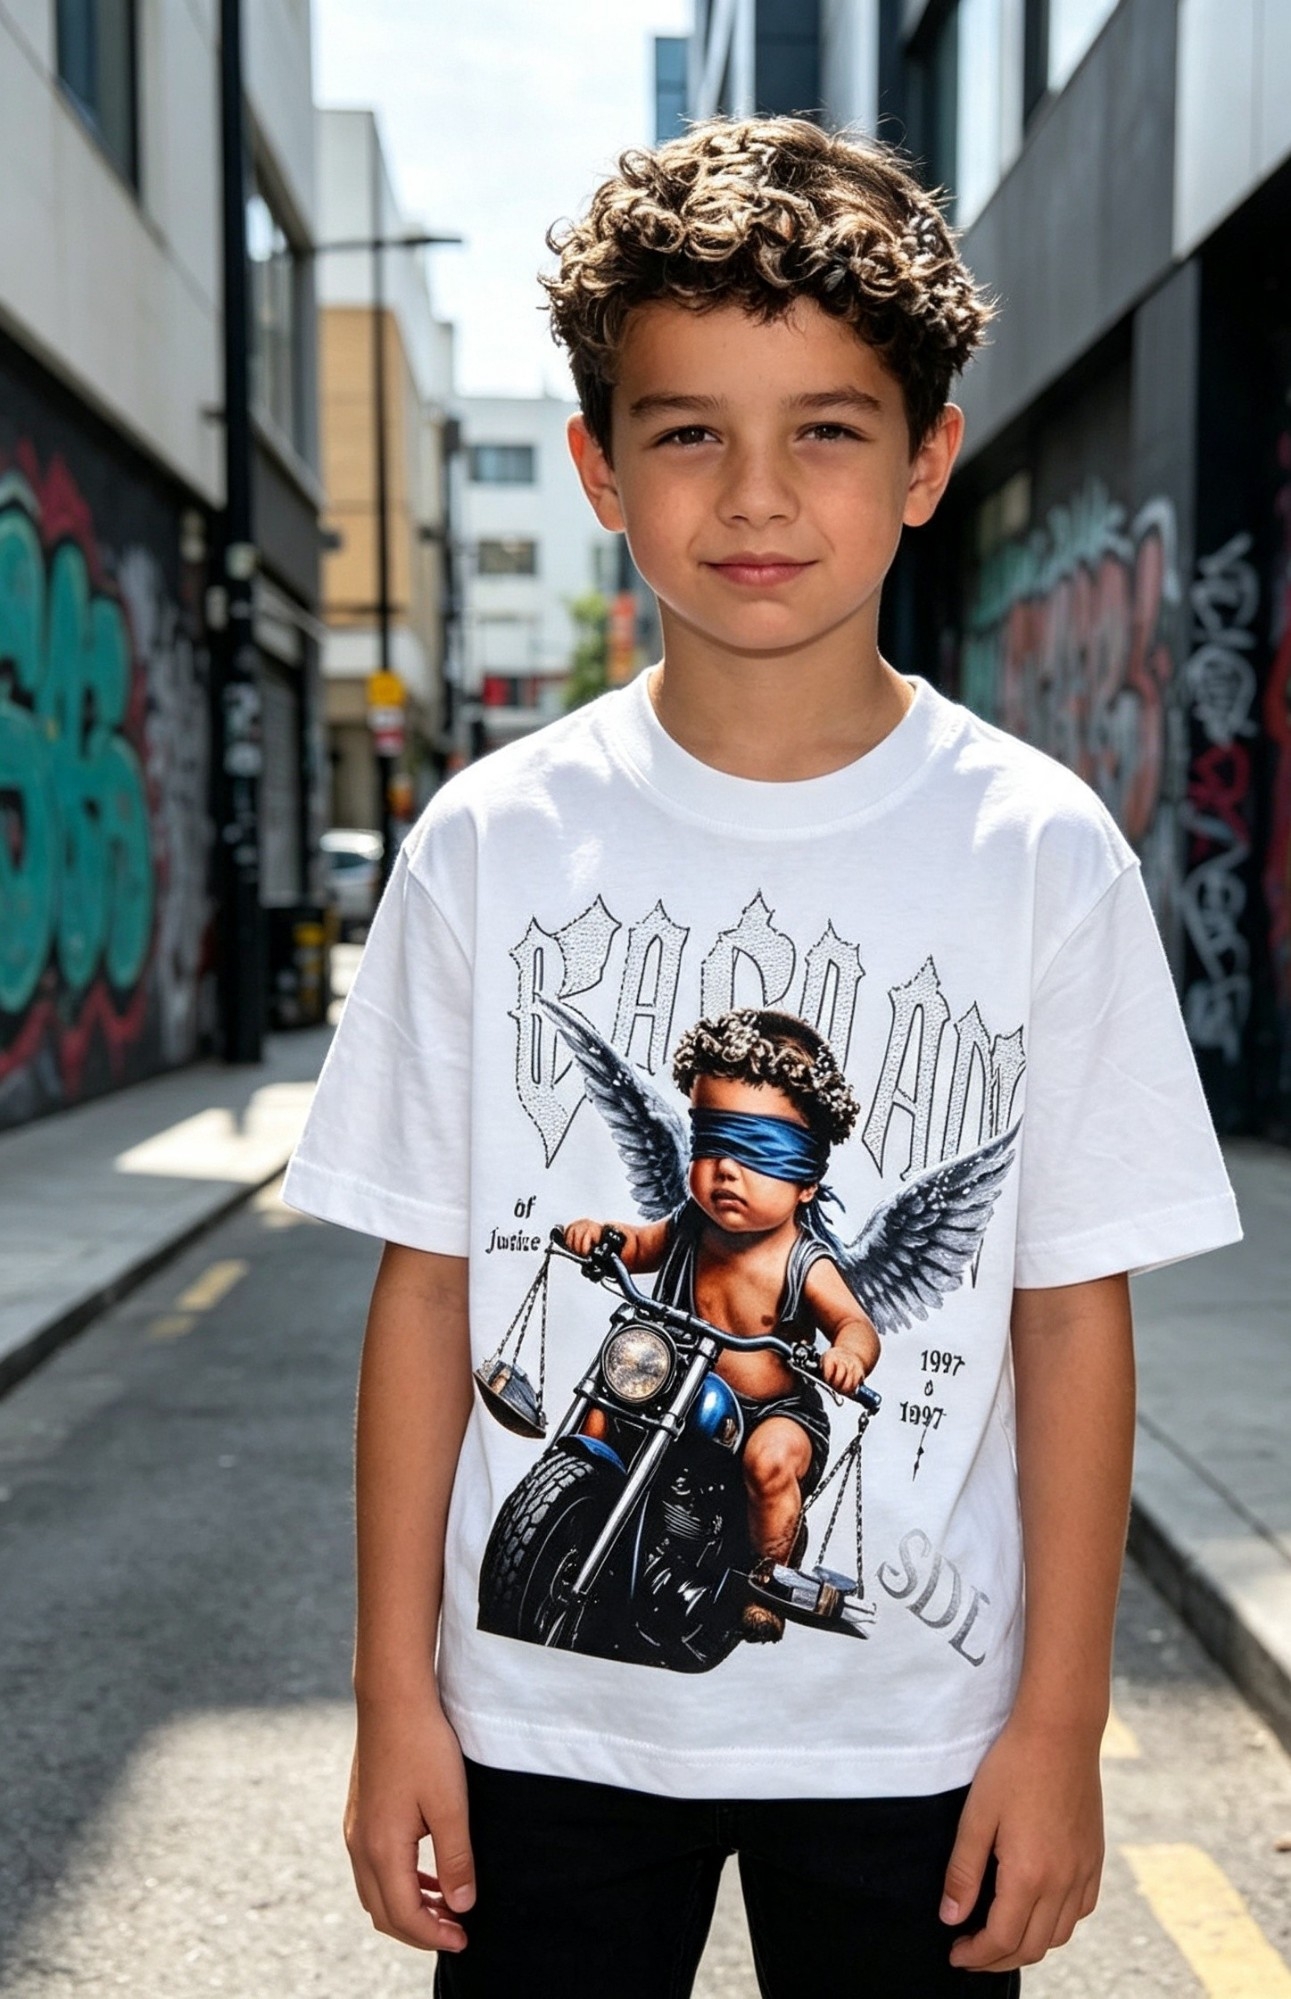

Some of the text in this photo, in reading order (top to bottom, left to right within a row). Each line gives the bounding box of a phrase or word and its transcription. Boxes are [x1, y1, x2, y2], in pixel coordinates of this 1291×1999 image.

[513, 1195, 538, 1219] of
[920, 1349, 966, 1377] 1997
[876, 1528, 991, 1668] SDL
